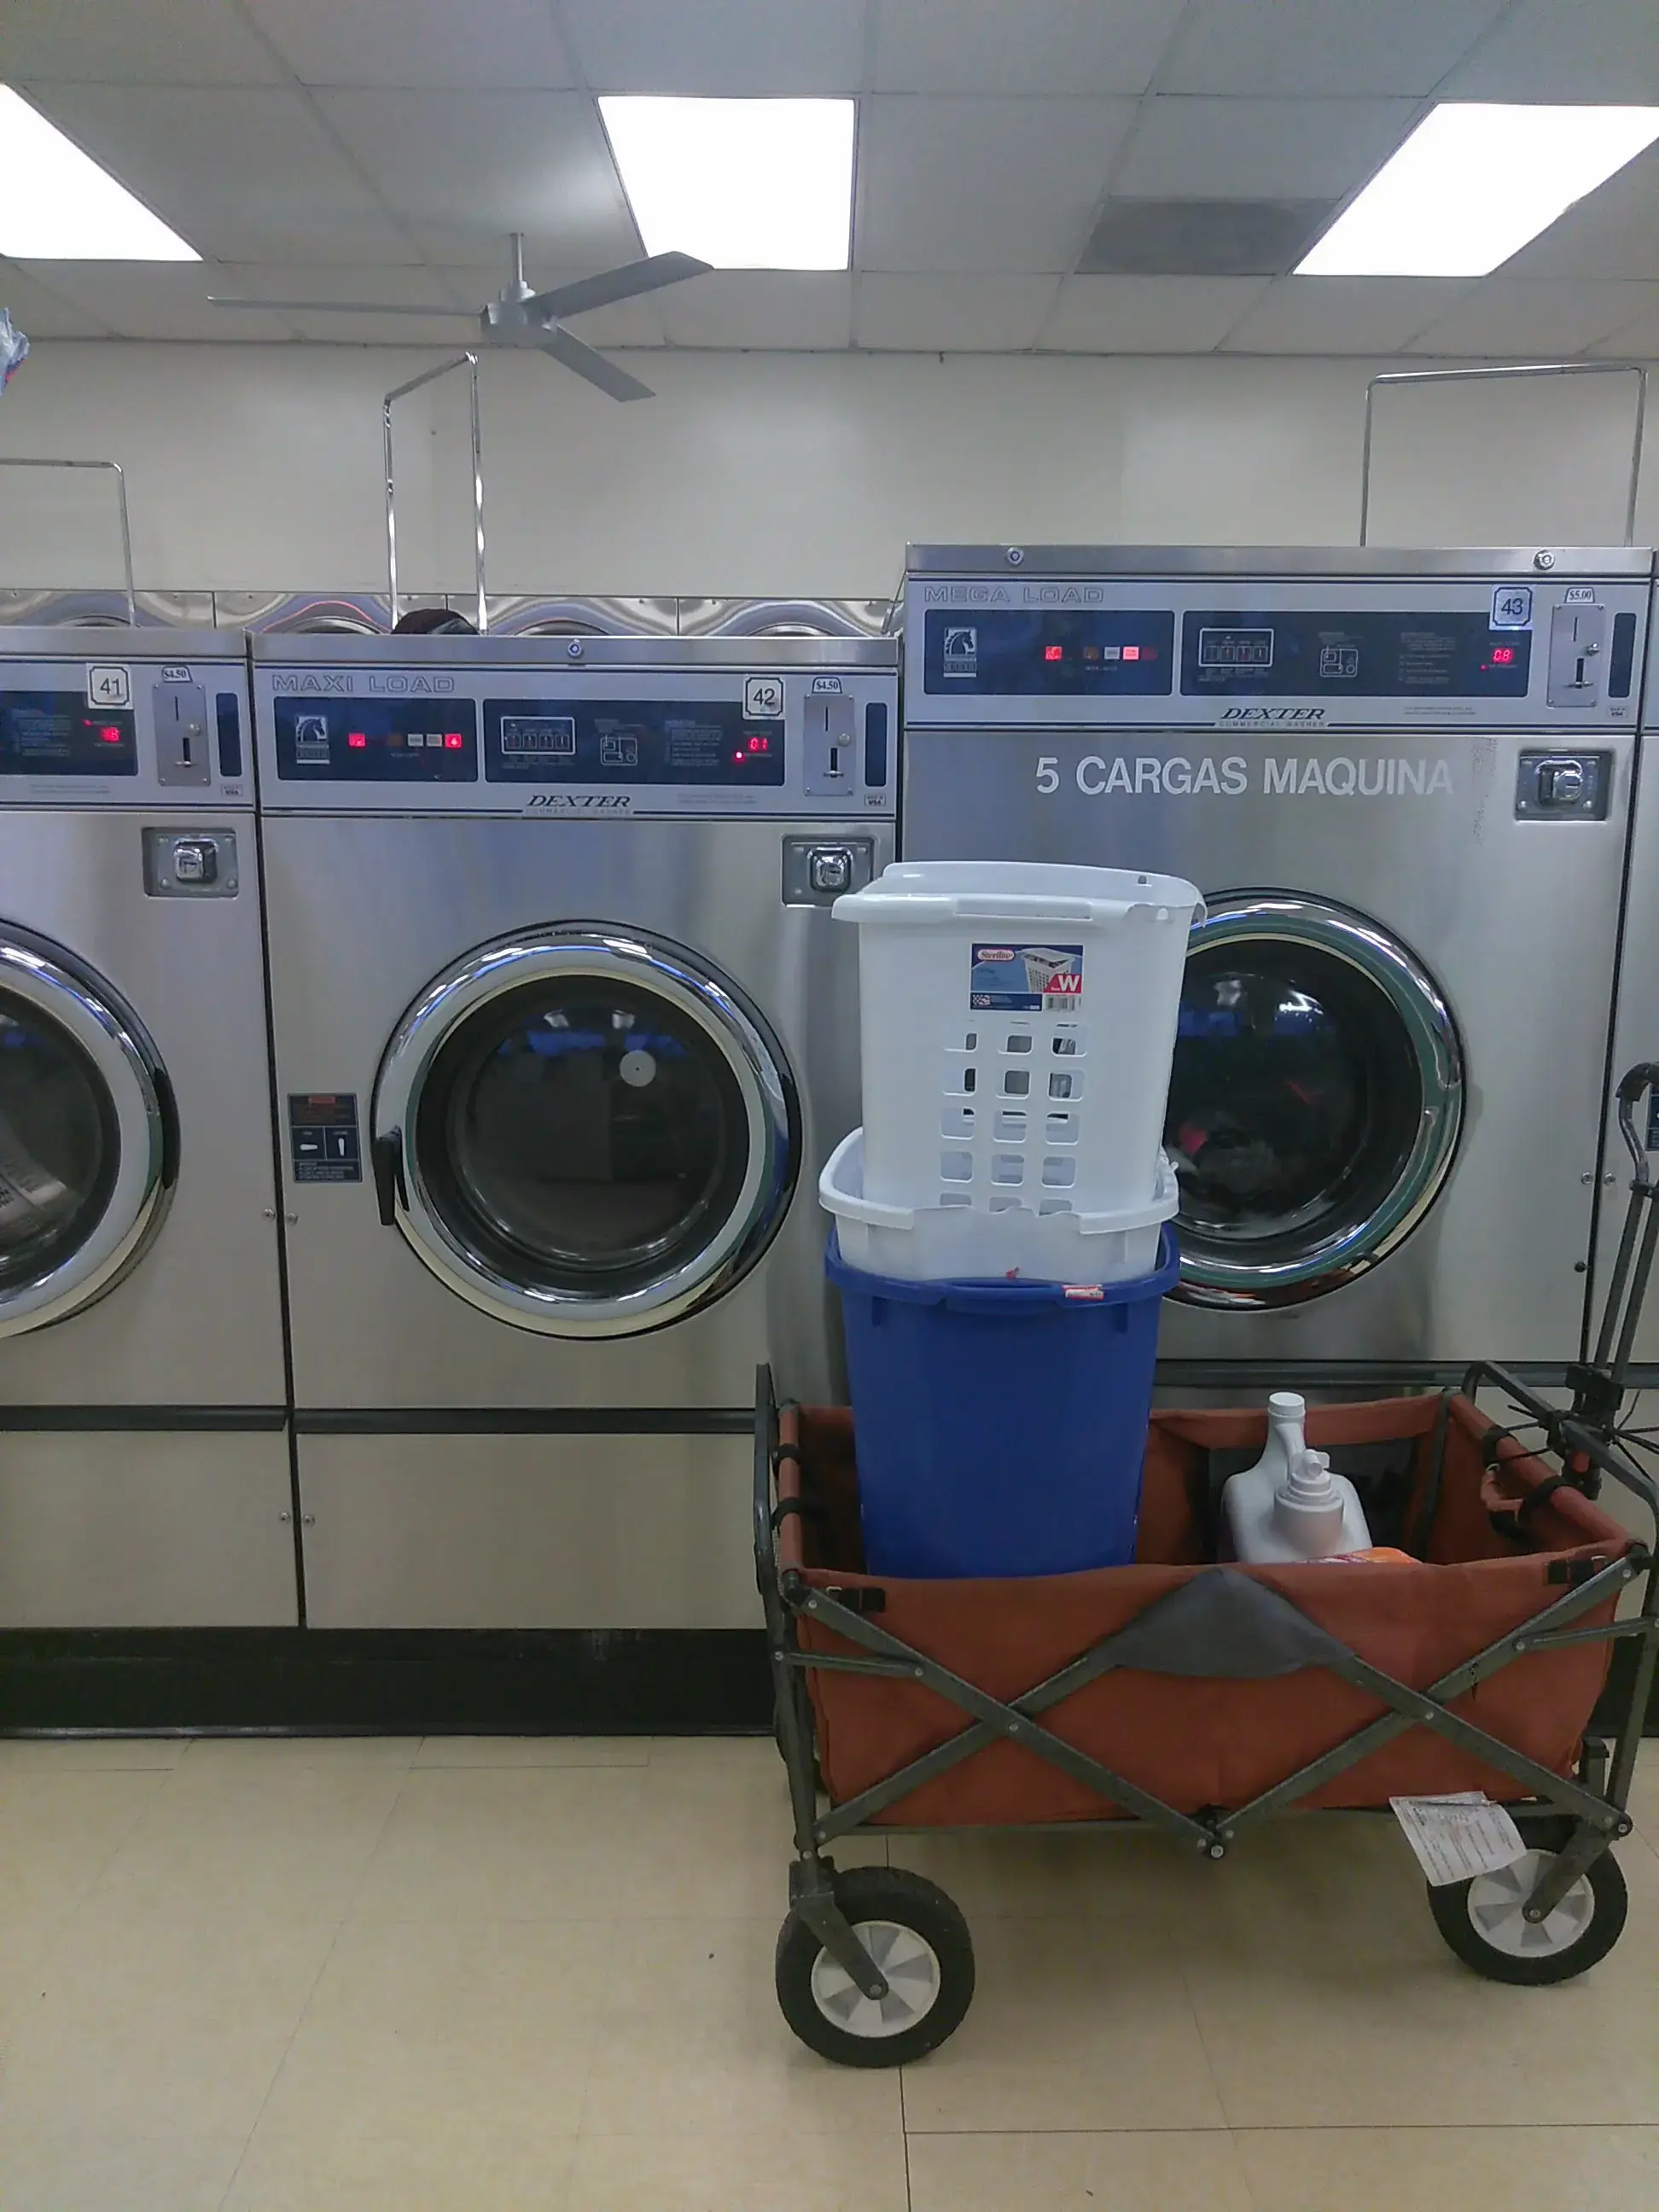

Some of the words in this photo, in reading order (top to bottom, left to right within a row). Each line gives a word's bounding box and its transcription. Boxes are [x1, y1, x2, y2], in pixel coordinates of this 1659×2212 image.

[924, 586, 1010, 602] MEGA
[1023, 587, 1103, 603] LOAD
[1569, 591, 1592, 601] $5.00
[1500, 597, 1523, 616] 43
[99, 677, 120, 696] 41
[272, 675, 353, 691] MAXI
[369, 675, 455, 693] LOAD
[815, 680, 839, 690] $4.50
[753, 688, 776, 707] 42
[1220, 707, 1325, 720] DEXTER
[1035, 756, 1060, 795] 5
[1075, 755, 1248, 796] CARGAS
[1263, 757, 1454, 797] MAQUINA
[527, 795, 632, 807] DEXTER
[1058, 975, 1080, 992] W
